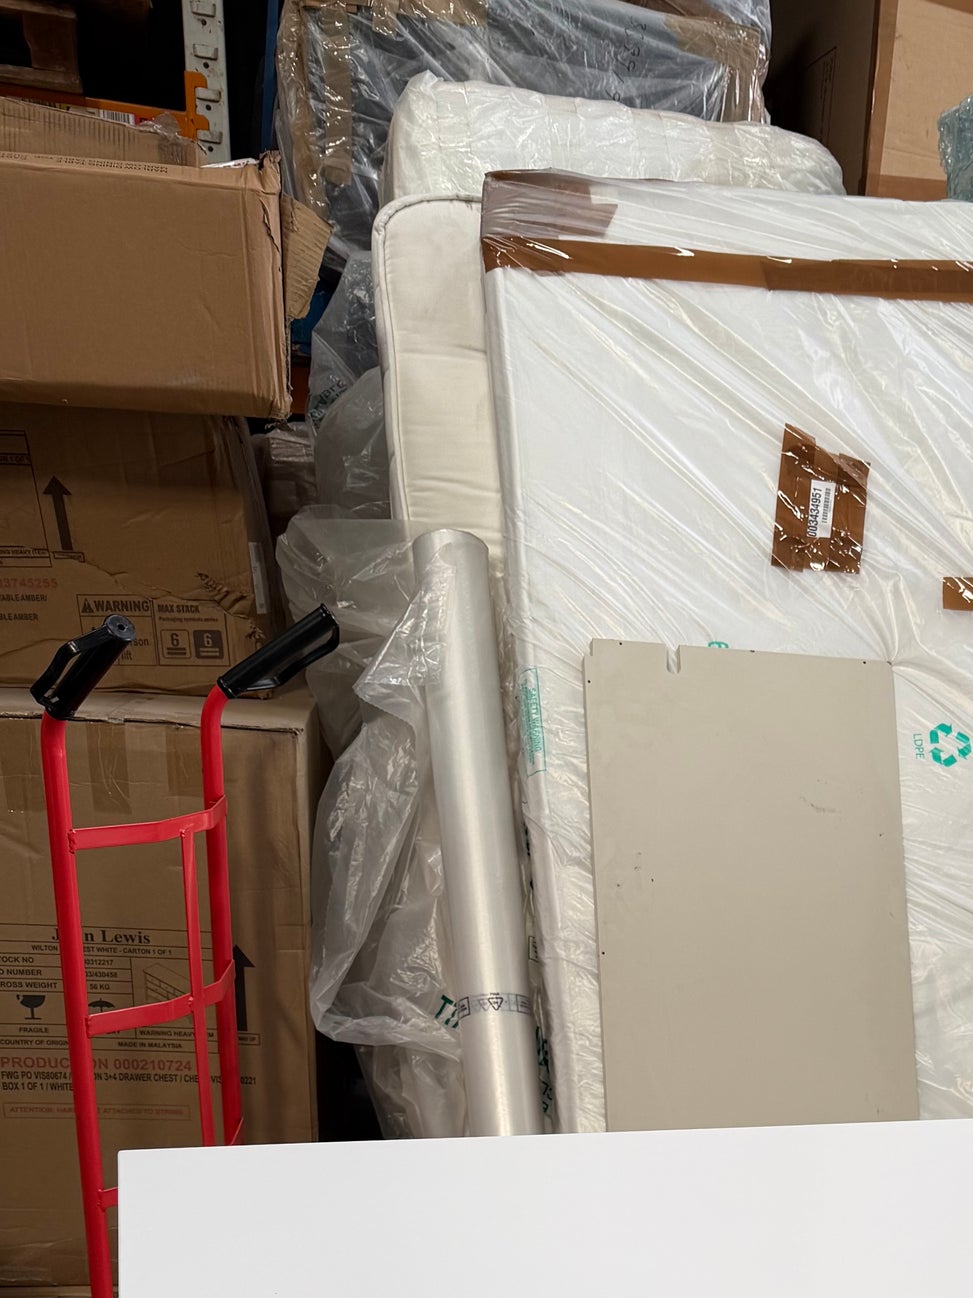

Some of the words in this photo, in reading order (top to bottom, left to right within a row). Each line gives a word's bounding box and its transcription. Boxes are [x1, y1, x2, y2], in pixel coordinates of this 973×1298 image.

[806, 488, 822, 537] 003434951
[94, 599, 150, 612] WARNING
[158, 603, 174, 613] MAX
[176, 604, 201, 613] STACK
[170, 632, 180, 647] 6
[203, 632, 213, 647] 6
[912, 733, 925, 760] LDPE
[52, 928, 94, 942] Jn
[101, 929, 151, 944] Lewis
[31, 944, 58, 952] WILTON
[122, 947, 151, 955] CARTON
[22, 956, 34, 964] NO
[6, 968, 42, 976] NUMBER
[25, 981, 58, 989] WEIGHT
[18, 1026, 49, 1034] FRAGILE
[0, 1038, 33, 1046] COUNTRY
[1, 1056, 109, 1070] PRODUCN
[113, 1057, 192, 1072] 000210724
[2, 1071, 20, 1080] FWG
[21, 1071, 33, 1079] PO
[104, 1073, 118, 1081] 3+4
[118, 1073, 151, 1082] DRAWER
[153, 1073, 178, 1083] CHEST
[2, 1081, 19, 1091] BOX
[21, 1082, 26, 1091] 1
[26, 1082, 38, 1091] OF
[39, 1083, 44, 1091] 1
